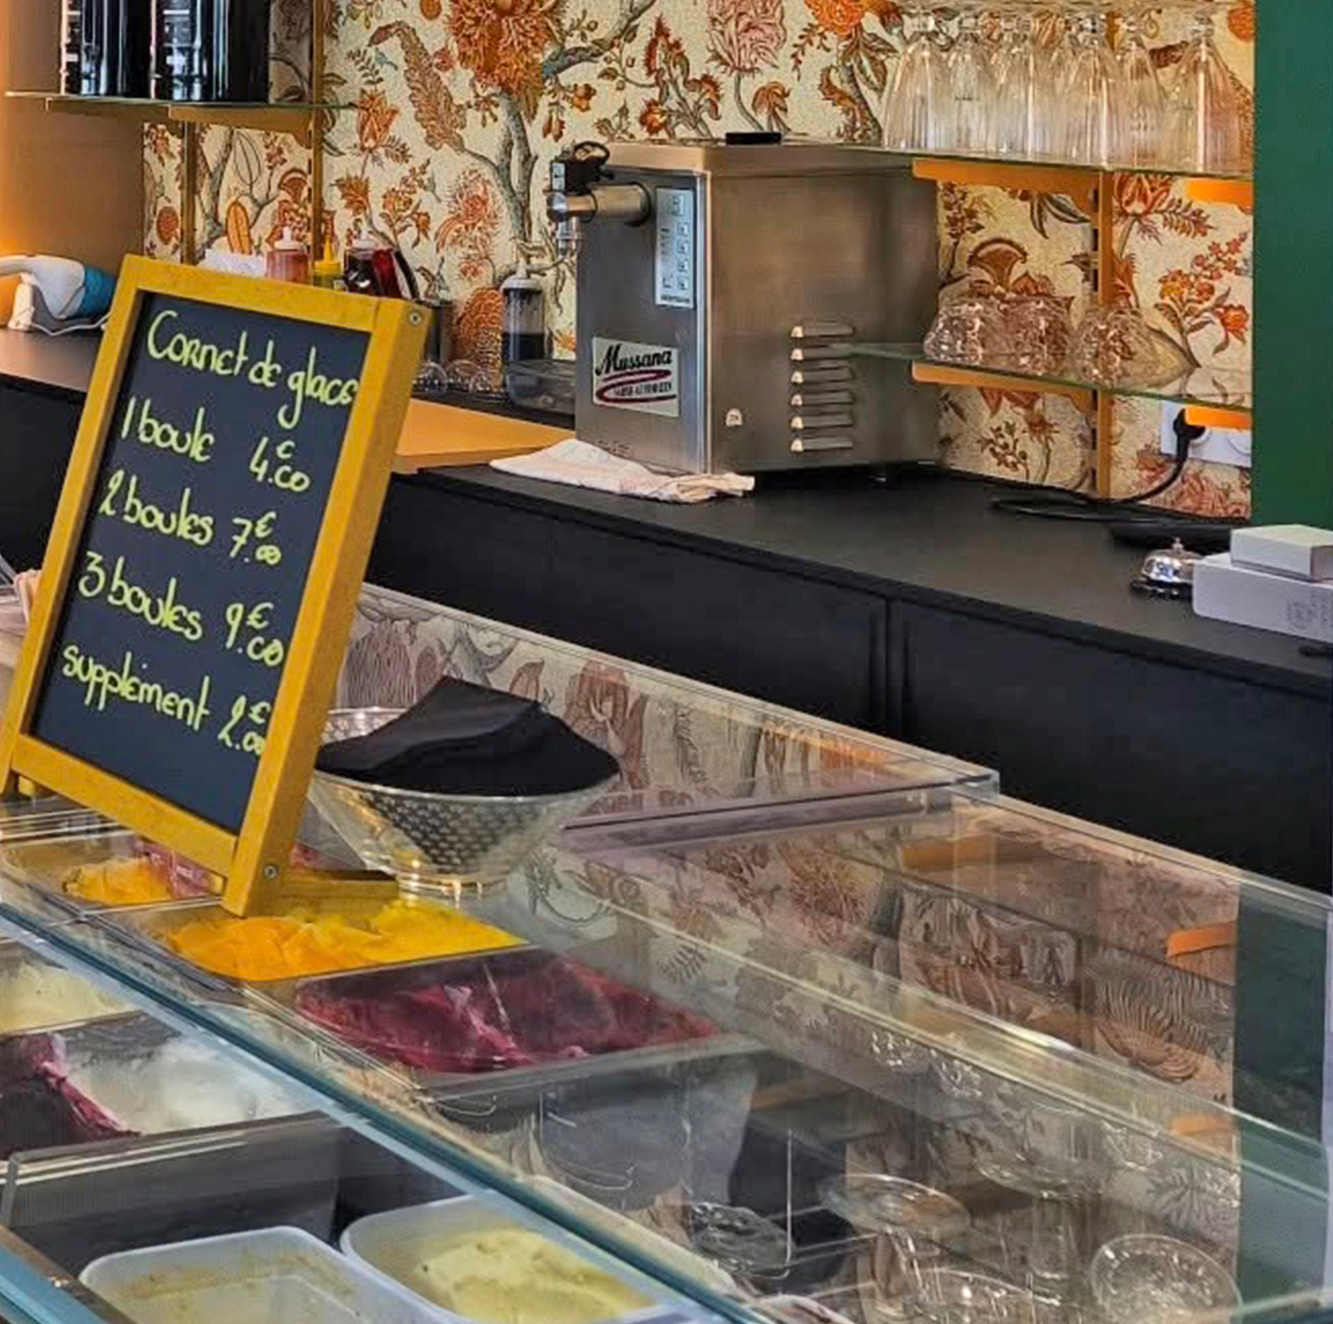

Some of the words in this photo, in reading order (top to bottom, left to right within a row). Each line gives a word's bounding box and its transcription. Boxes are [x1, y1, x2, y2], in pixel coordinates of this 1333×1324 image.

[148, 310, 248, 375] Cornet
[248, 339, 282, 387] de
[595, 343, 672, 376] Mussana
[121, 396, 136, 439] 1
[138, 398, 215, 462] boule
[99, 469, 125, 516] 2
[123, 475, 214, 545] boules
[78, 551, 105, 597] 3
[108, 555, 202, 640] boules
